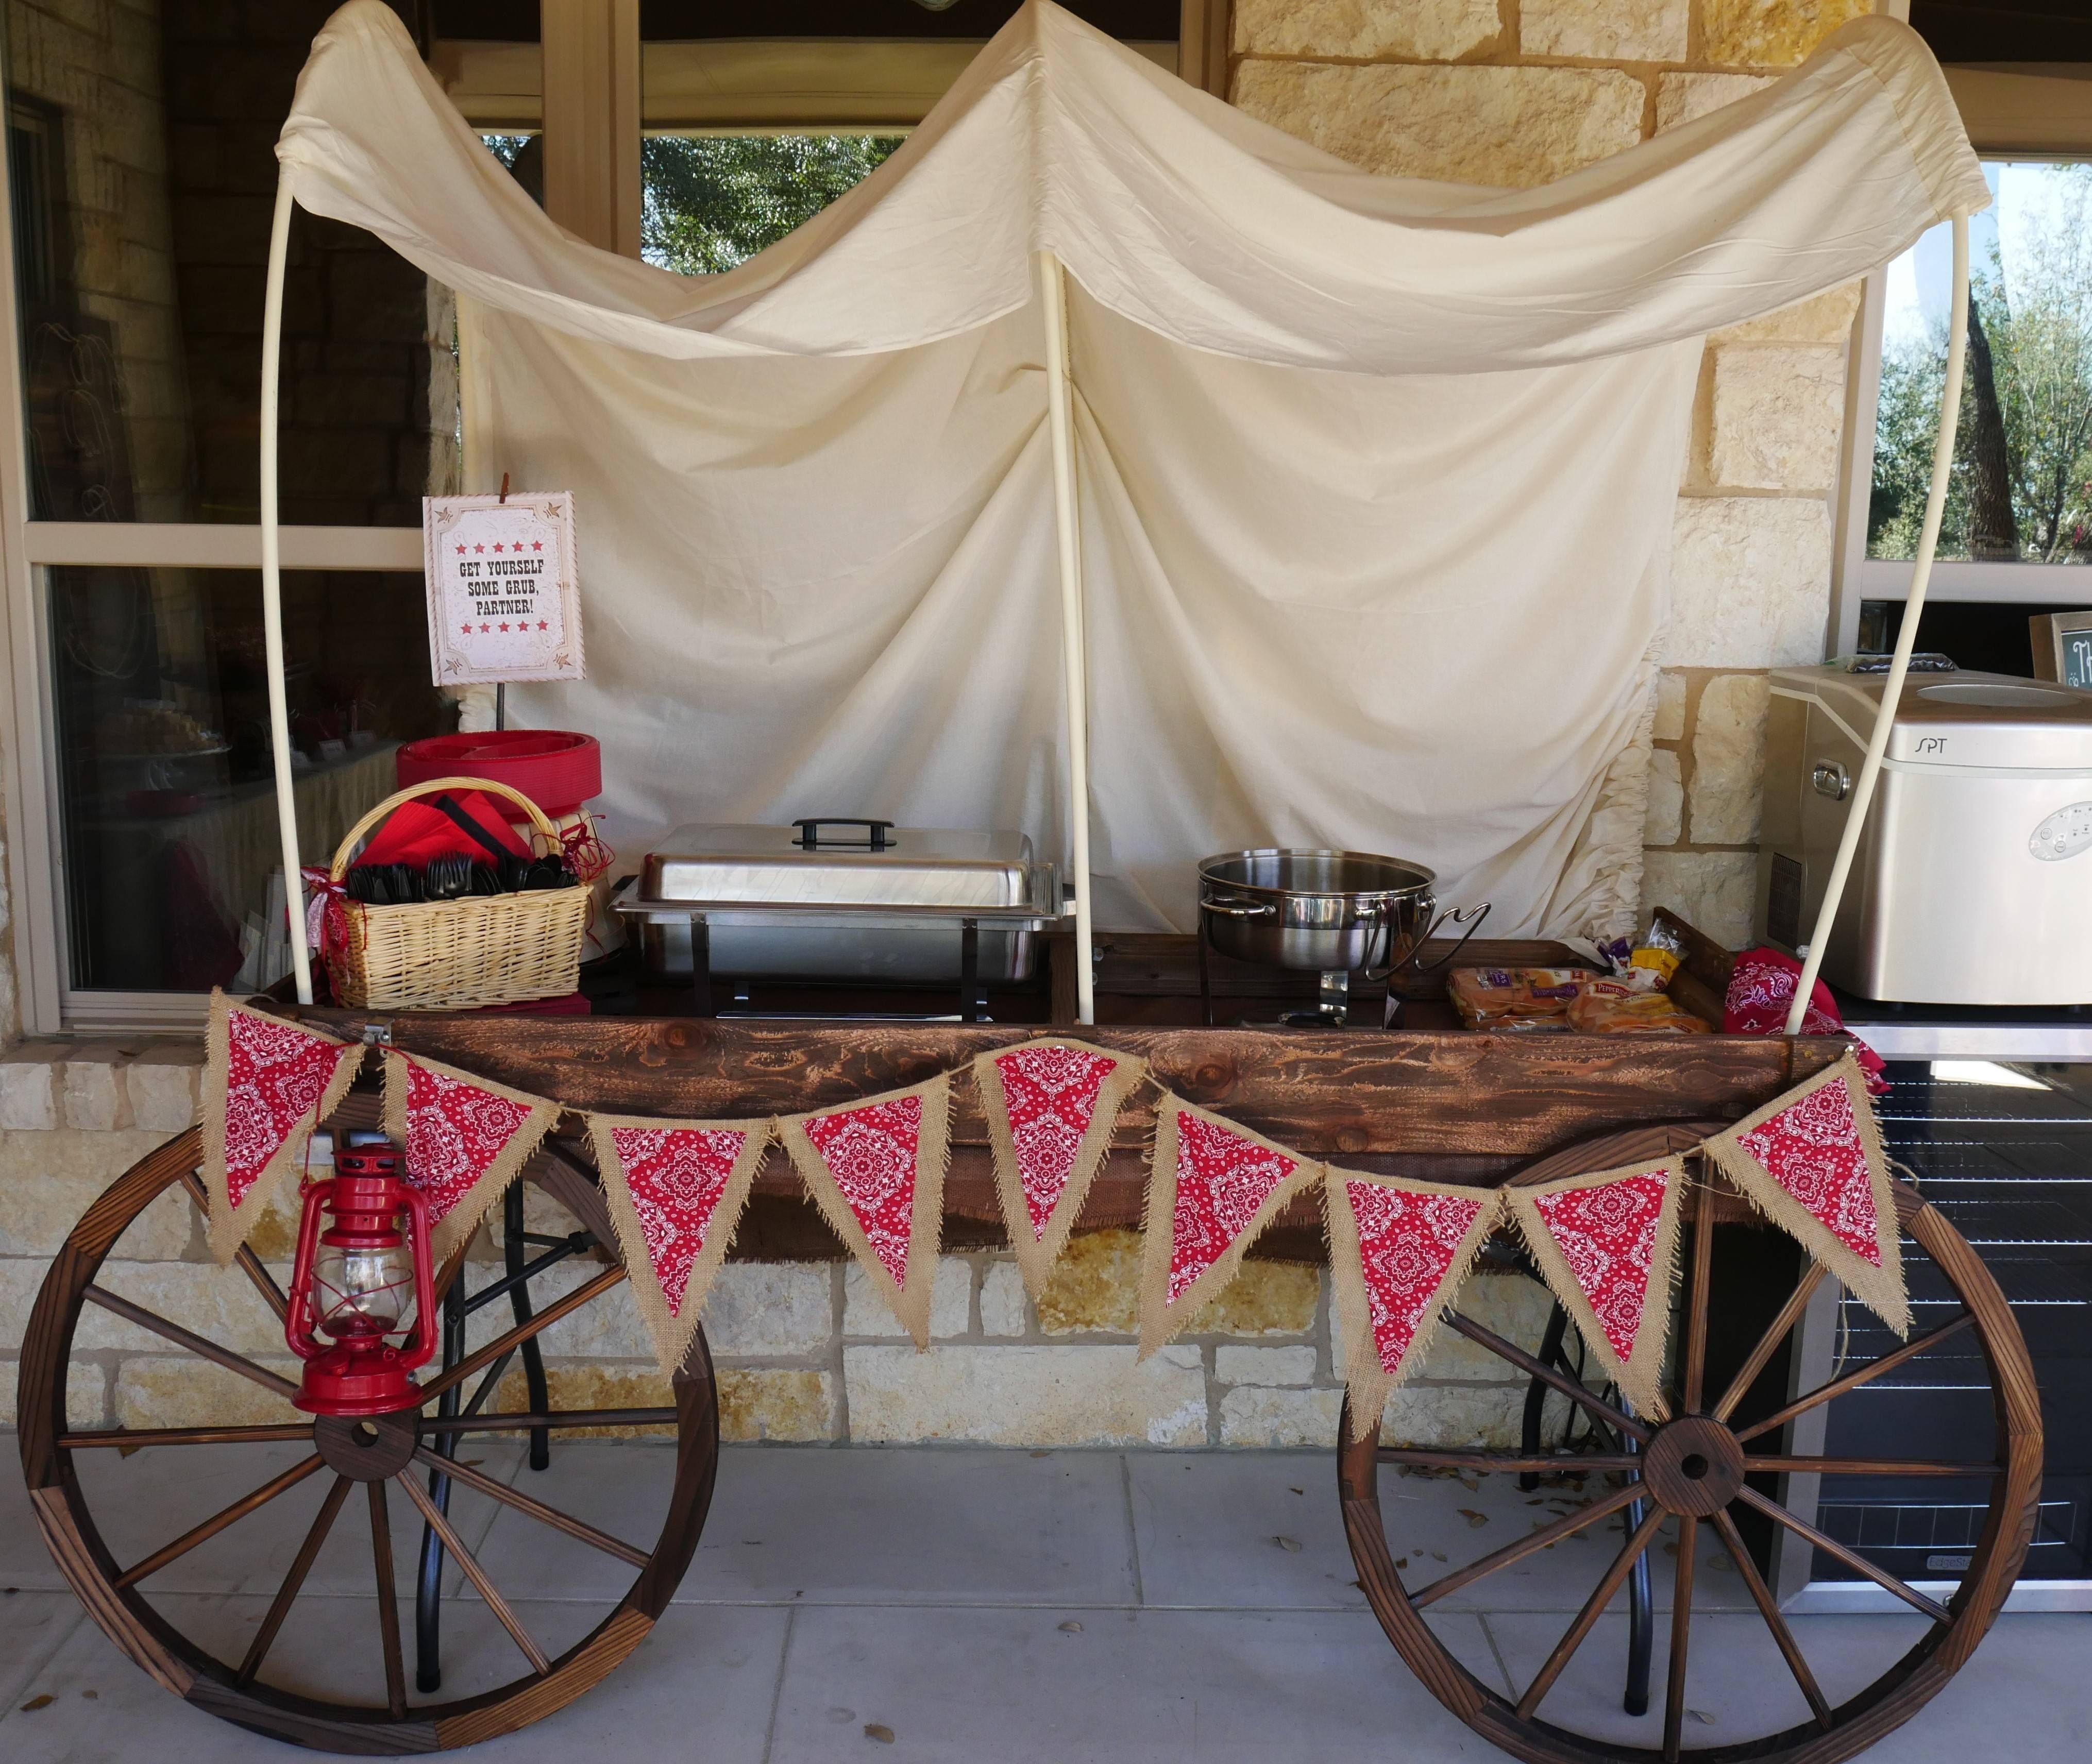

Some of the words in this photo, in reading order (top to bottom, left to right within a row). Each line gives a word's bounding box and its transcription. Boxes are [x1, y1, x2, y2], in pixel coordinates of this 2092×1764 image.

[460, 562, 480, 577] GET
[487, 559, 544, 576] YOURSELF
[468, 581, 499, 597] SOME
[505, 579, 539, 596] GRUB,
[476, 599, 533, 616] PARTNER!
[1915, 738, 1947, 753] SPT
